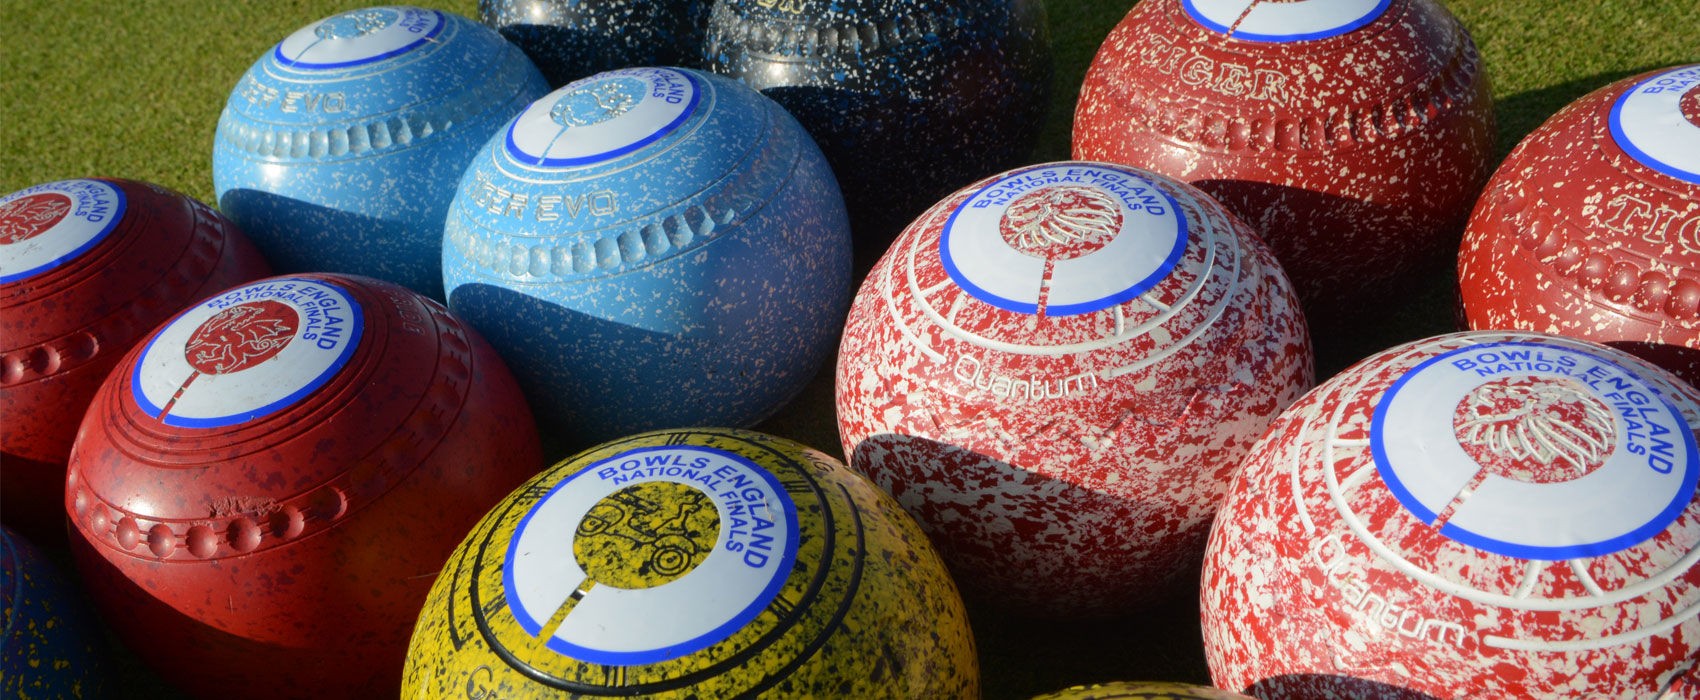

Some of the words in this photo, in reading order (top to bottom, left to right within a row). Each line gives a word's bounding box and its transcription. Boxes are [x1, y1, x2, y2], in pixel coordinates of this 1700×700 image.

[281, 90, 346, 114] EVO
[1141, 34, 1290, 103] TIGER
[535, 190, 617, 223] EVO
[972, 170, 1058, 209] BOWLS
[1067, 168, 1166, 217] ENGLAND
[993, 176, 1086, 206] NATIONAL
[1092, 178, 1143, 212] FINALS
[207, 282, 296, 309] BOWLS
[298, 286, 344, 351] ENGLAND
[218, 291, 304, 310] NATIONAL
[300, 300, 321, 341] FINALS
[953, 354, 1098, 401] Quantum
[1475, 361, 1601, 392] NATIONAL
[1603, 391, 1646, 457] FINALS
[1451, 350, 1577, 372] BOWLS
[1586, 365, 1675, 476] ENGLAND
[597, 454, 711, 481] BOWLS
[712, 464, 776, 569] ENGLAND
[612, 467, 720, 492] NATIONAL
[719, 490, 745, 553] FINALS
[1314, 534, 1465, 648] Quantum
